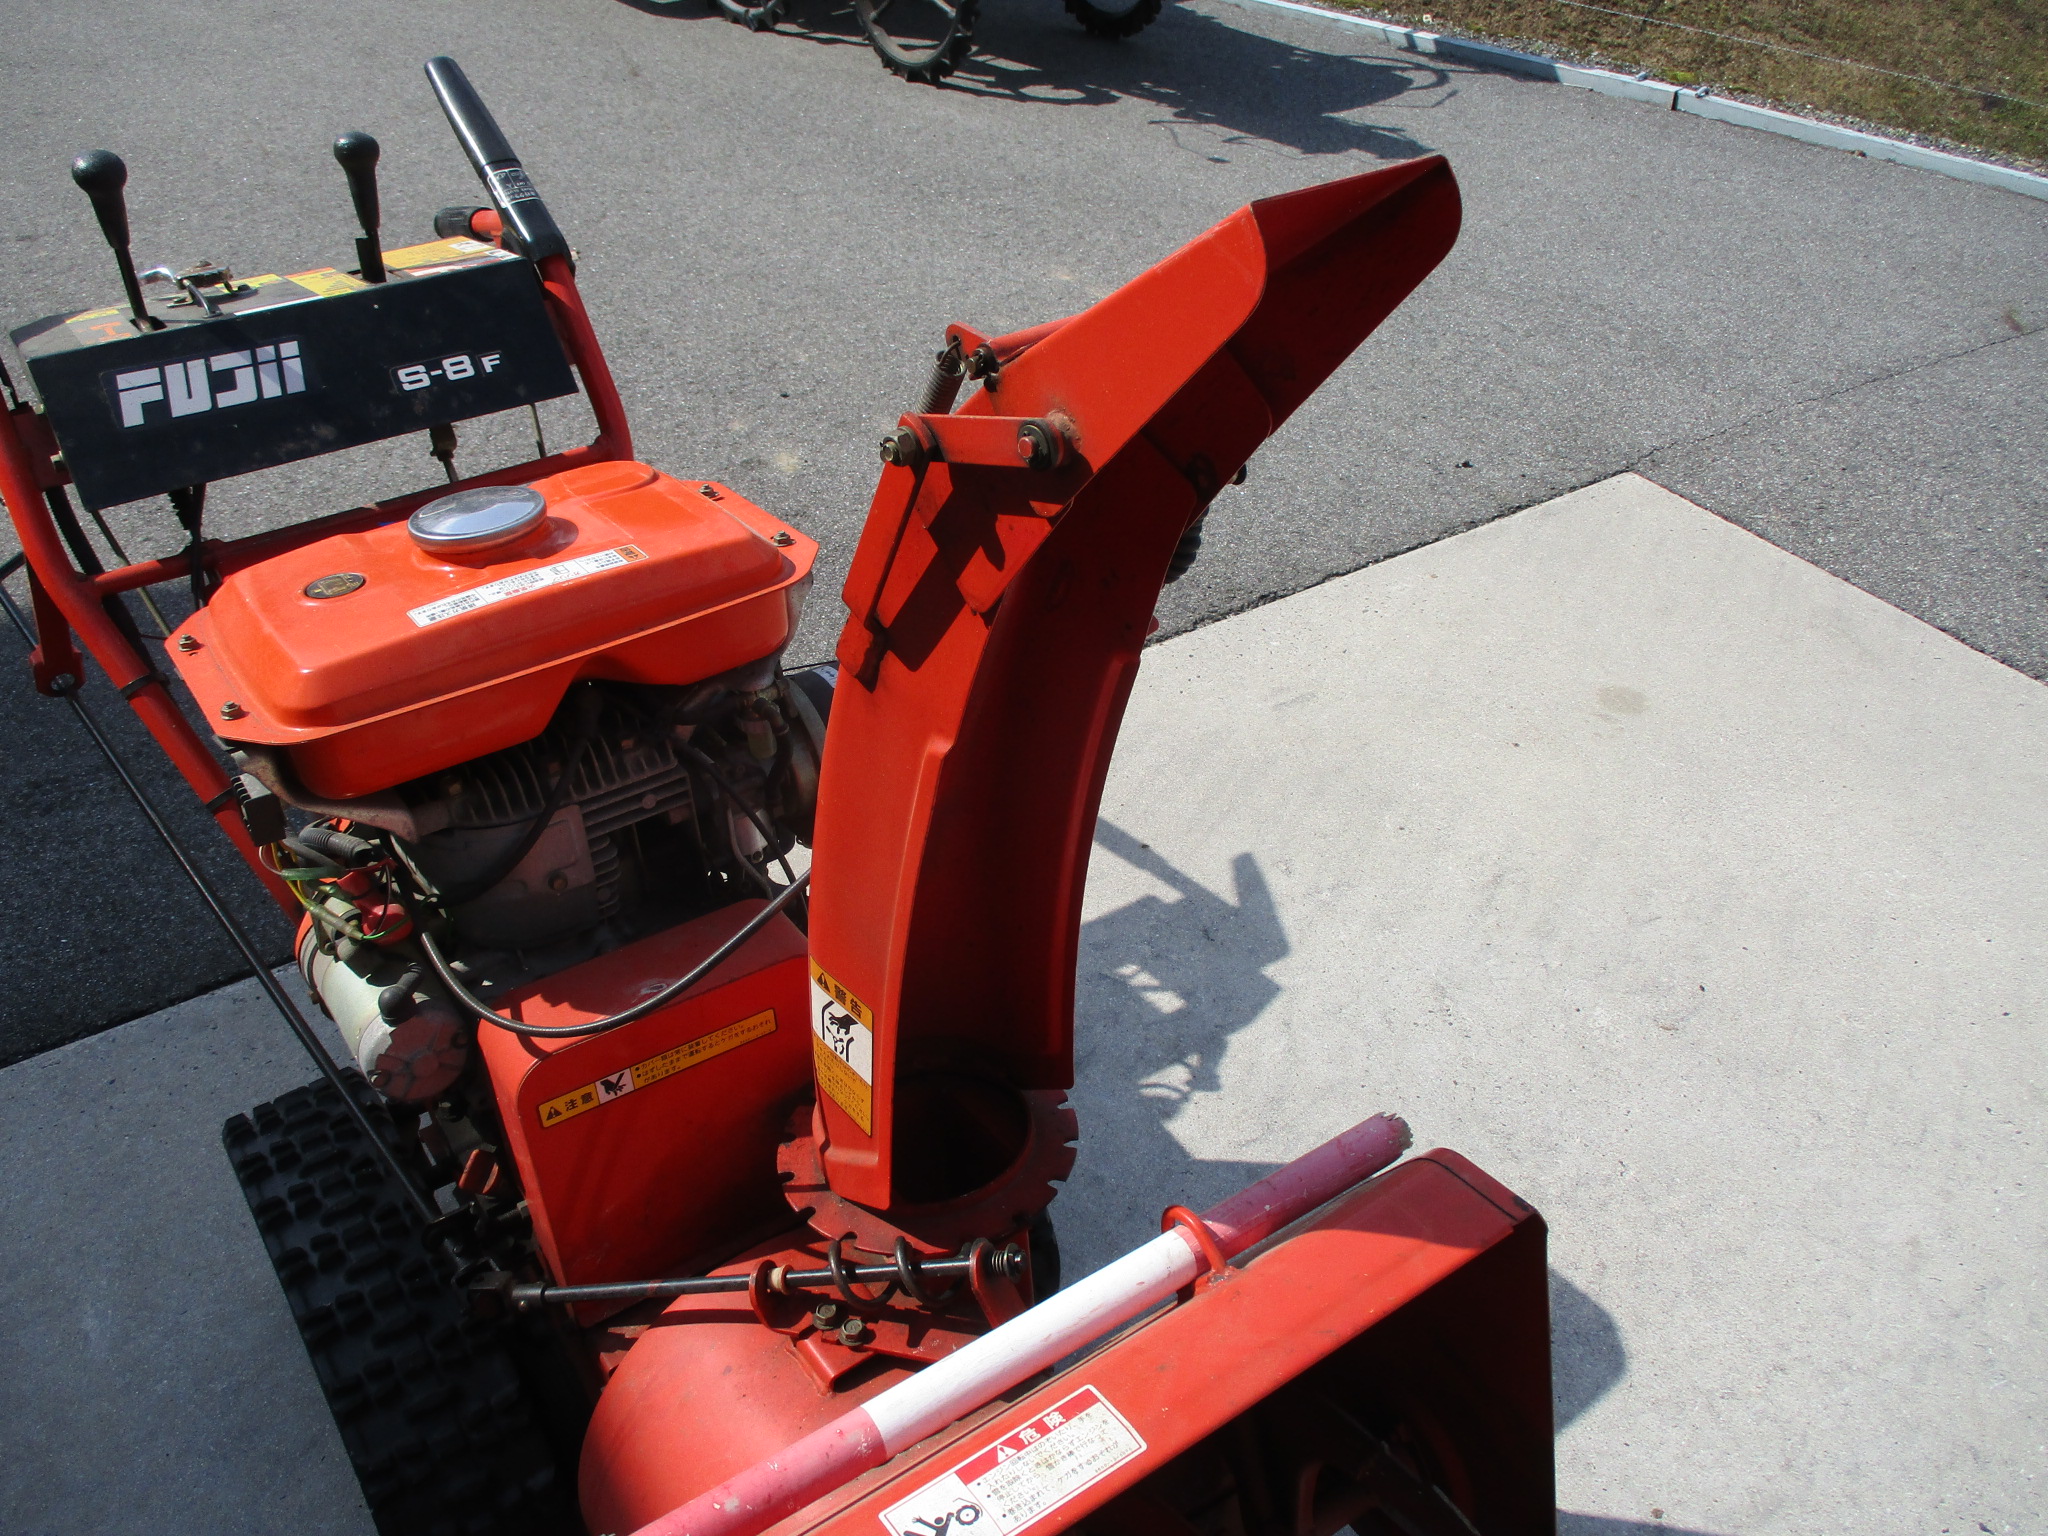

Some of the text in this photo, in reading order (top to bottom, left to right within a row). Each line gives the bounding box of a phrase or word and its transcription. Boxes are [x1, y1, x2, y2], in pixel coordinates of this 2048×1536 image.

[833, 983, 863, 1018] 警告
[563, 1090, 594, 1112] 注意
[1018, 1411, 1066, 1445] 危険
